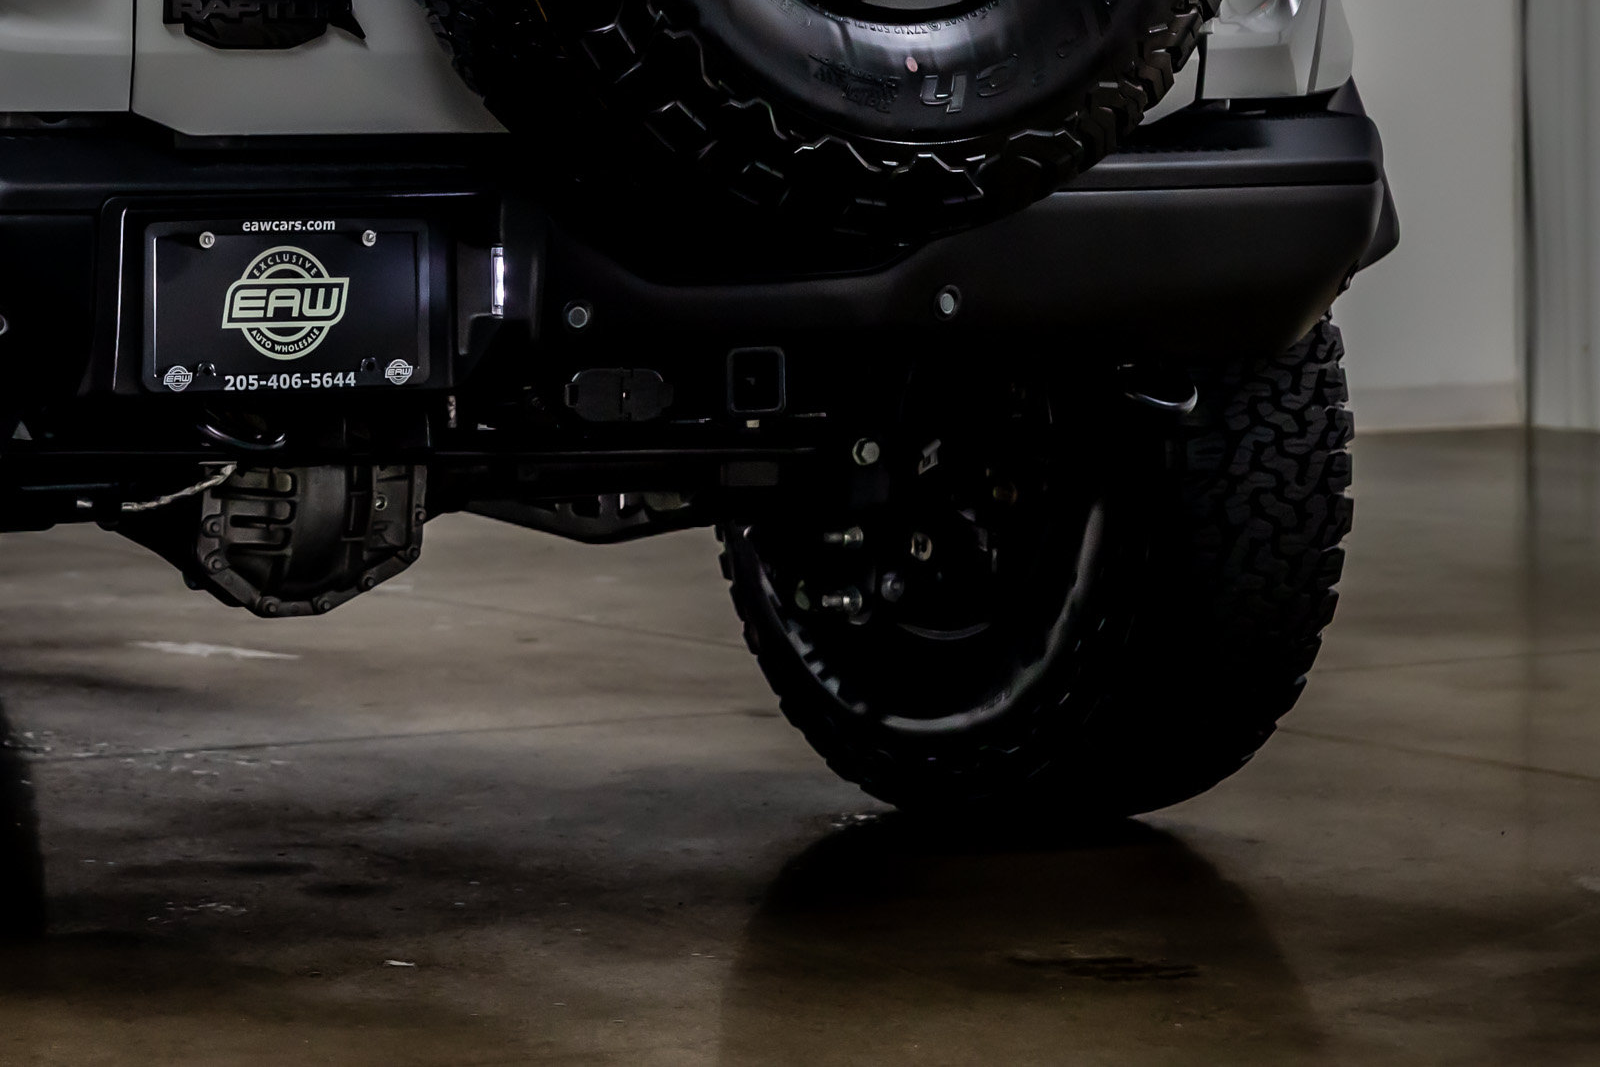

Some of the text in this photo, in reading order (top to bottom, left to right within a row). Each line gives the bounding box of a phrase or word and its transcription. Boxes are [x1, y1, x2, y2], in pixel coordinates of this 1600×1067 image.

[242, 220, 336, 232] eawcars.com
[253, 253, 318, 277] EXCLUSIVE
[232, 287, 339, 319] EAW
[251, 327, 321, 353] AUTO WHOLESALE
[165, 373, 192, 383] EAW
[224, 372, 357, 391] 205-406-5644
[386, 367, 412, 377] EAW
